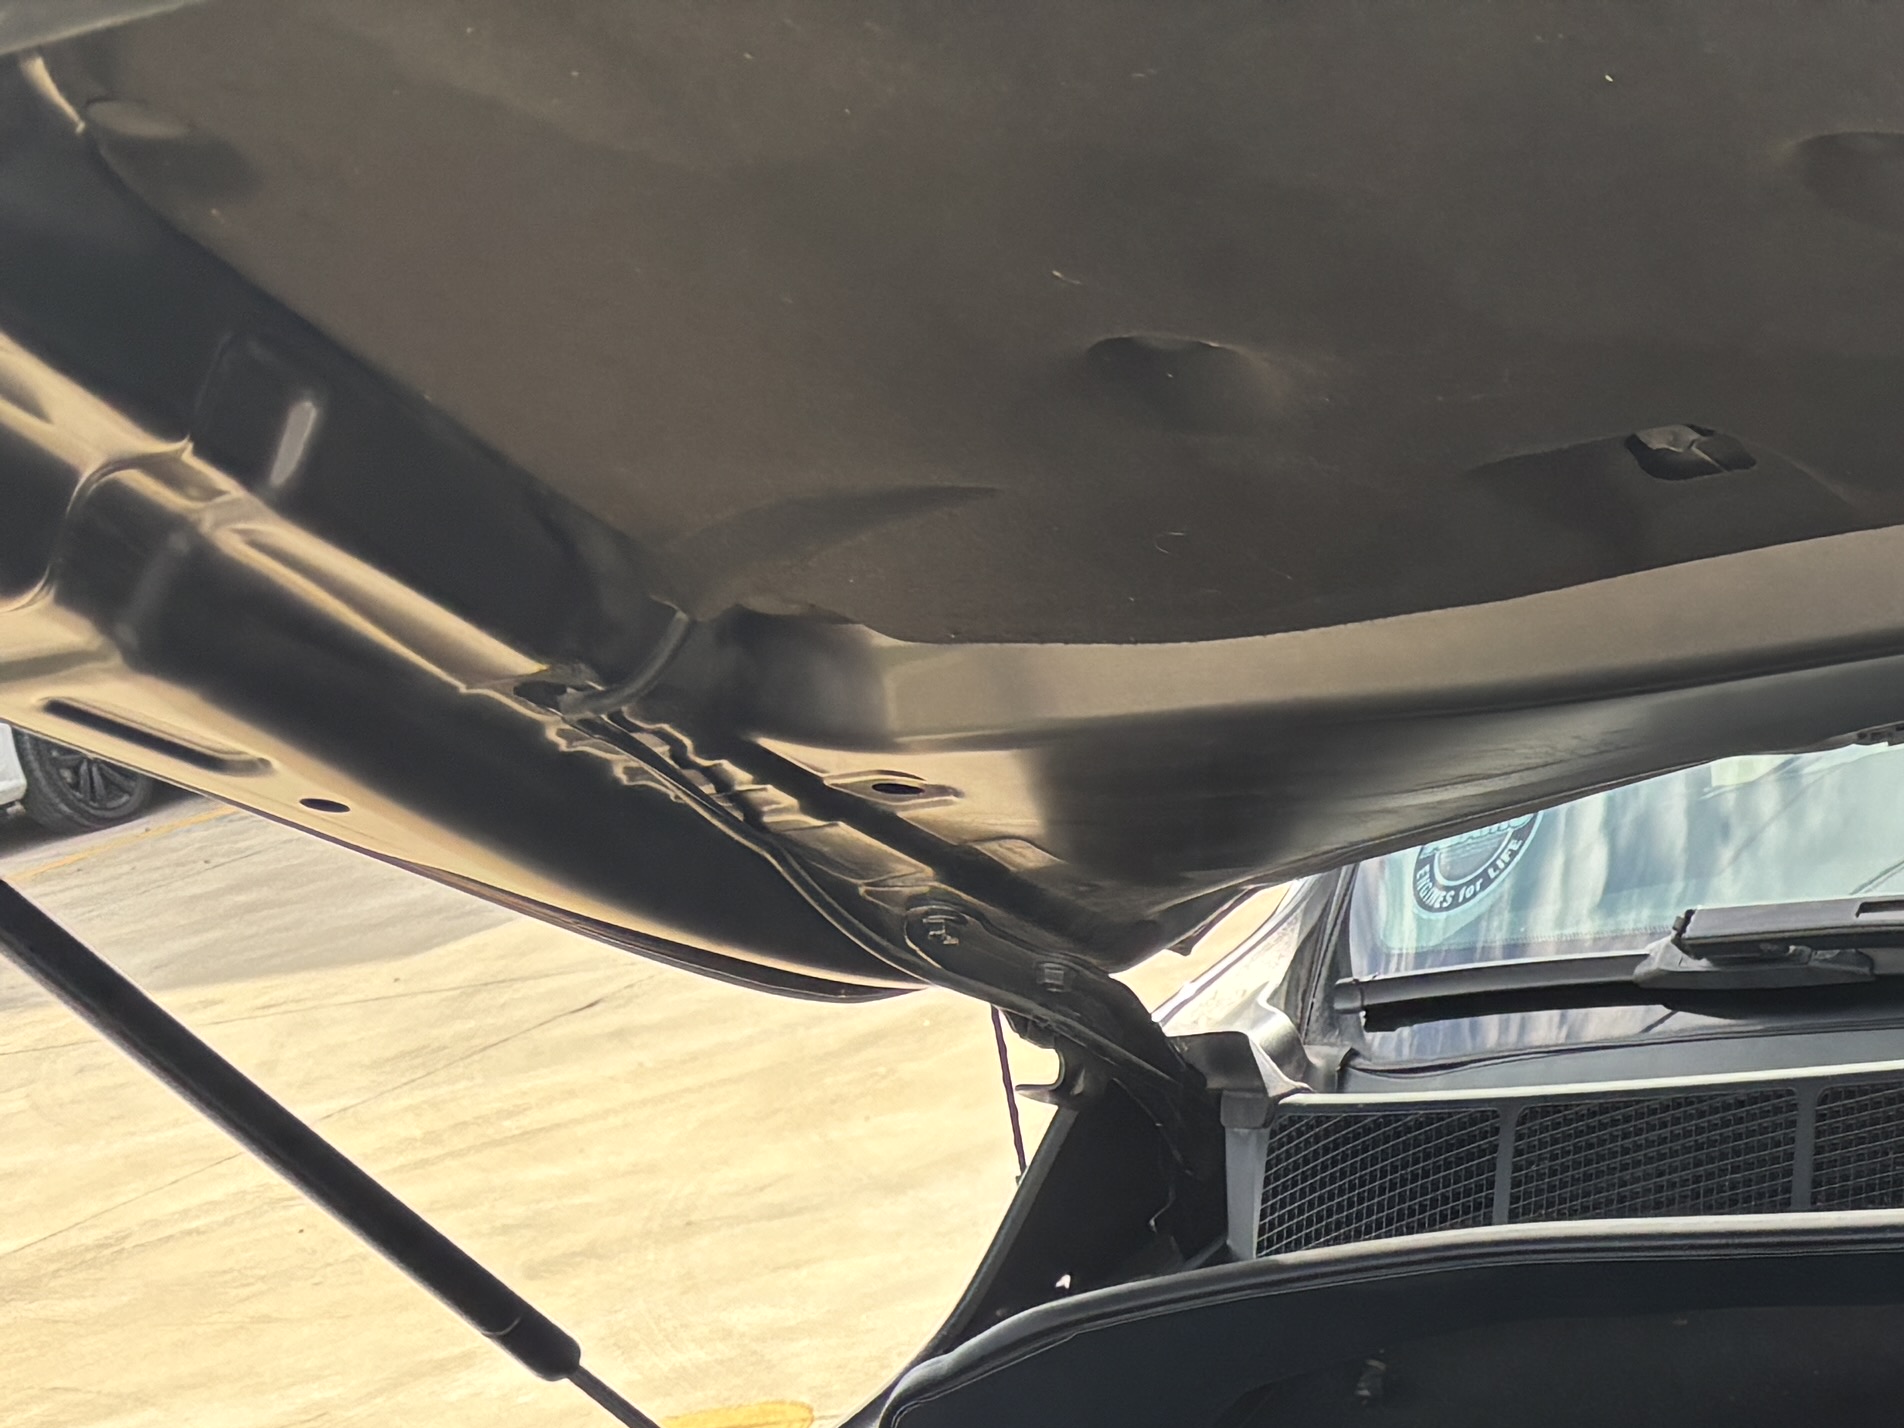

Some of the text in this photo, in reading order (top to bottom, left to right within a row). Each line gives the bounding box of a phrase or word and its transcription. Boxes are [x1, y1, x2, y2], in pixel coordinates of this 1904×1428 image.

[1416, 838, 1523, 909] ENGINES for LIFE
